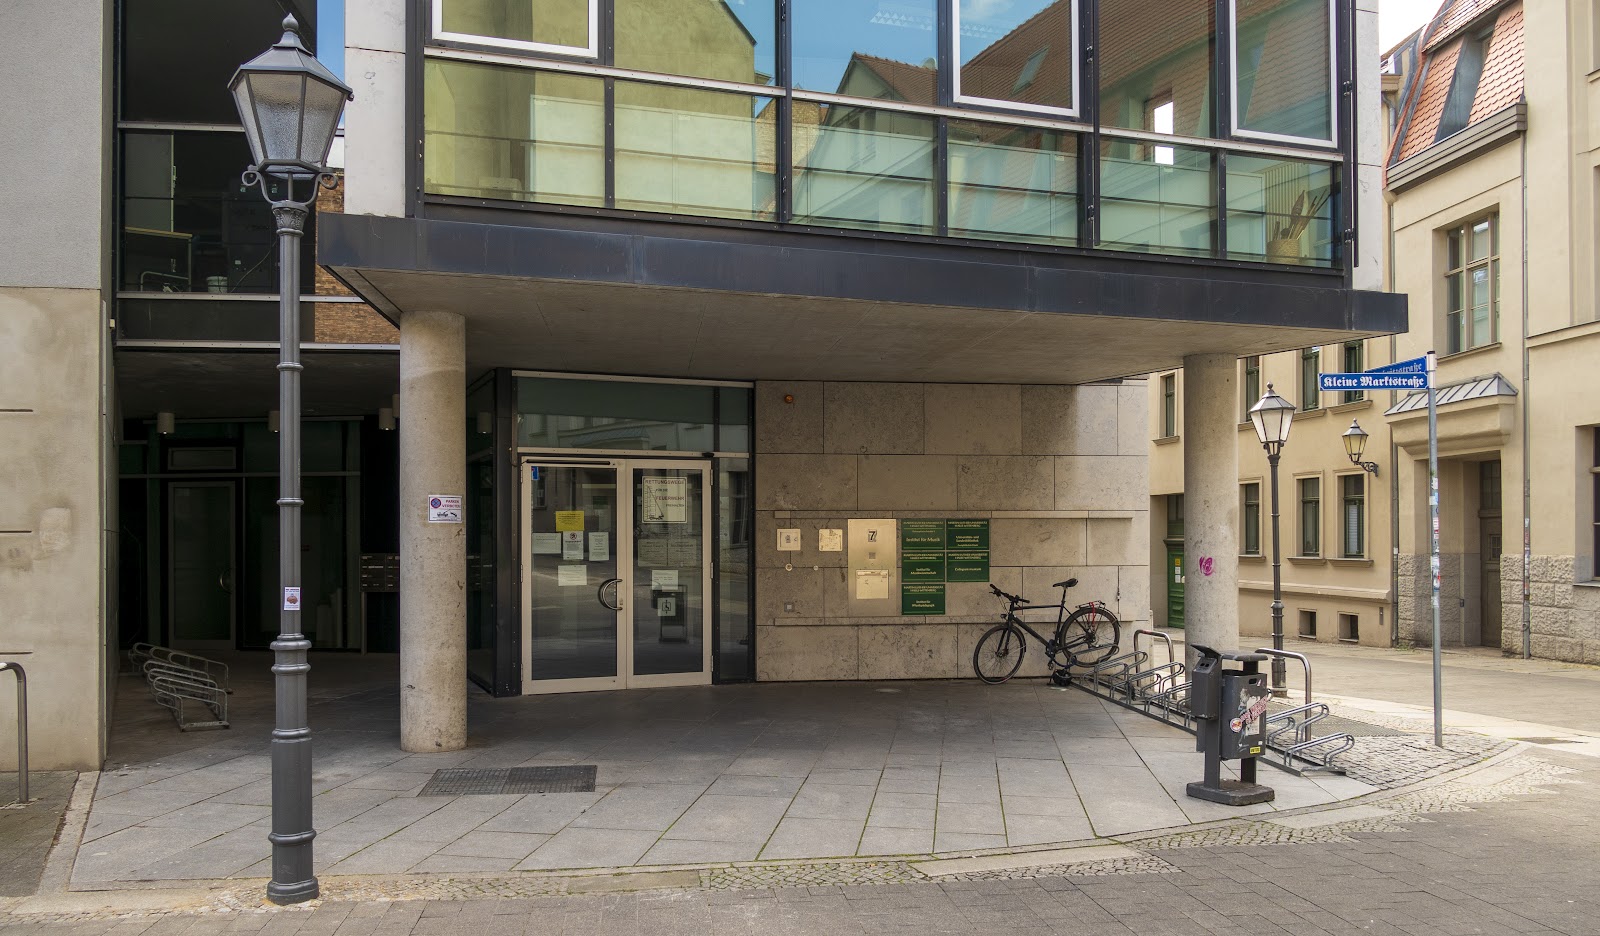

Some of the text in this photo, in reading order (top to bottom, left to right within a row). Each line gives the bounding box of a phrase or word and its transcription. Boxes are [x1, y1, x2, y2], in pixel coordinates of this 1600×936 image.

[1323, 375, 1425, 388] Kleine Marktstraße
[868, 530, 876, 541] 7
